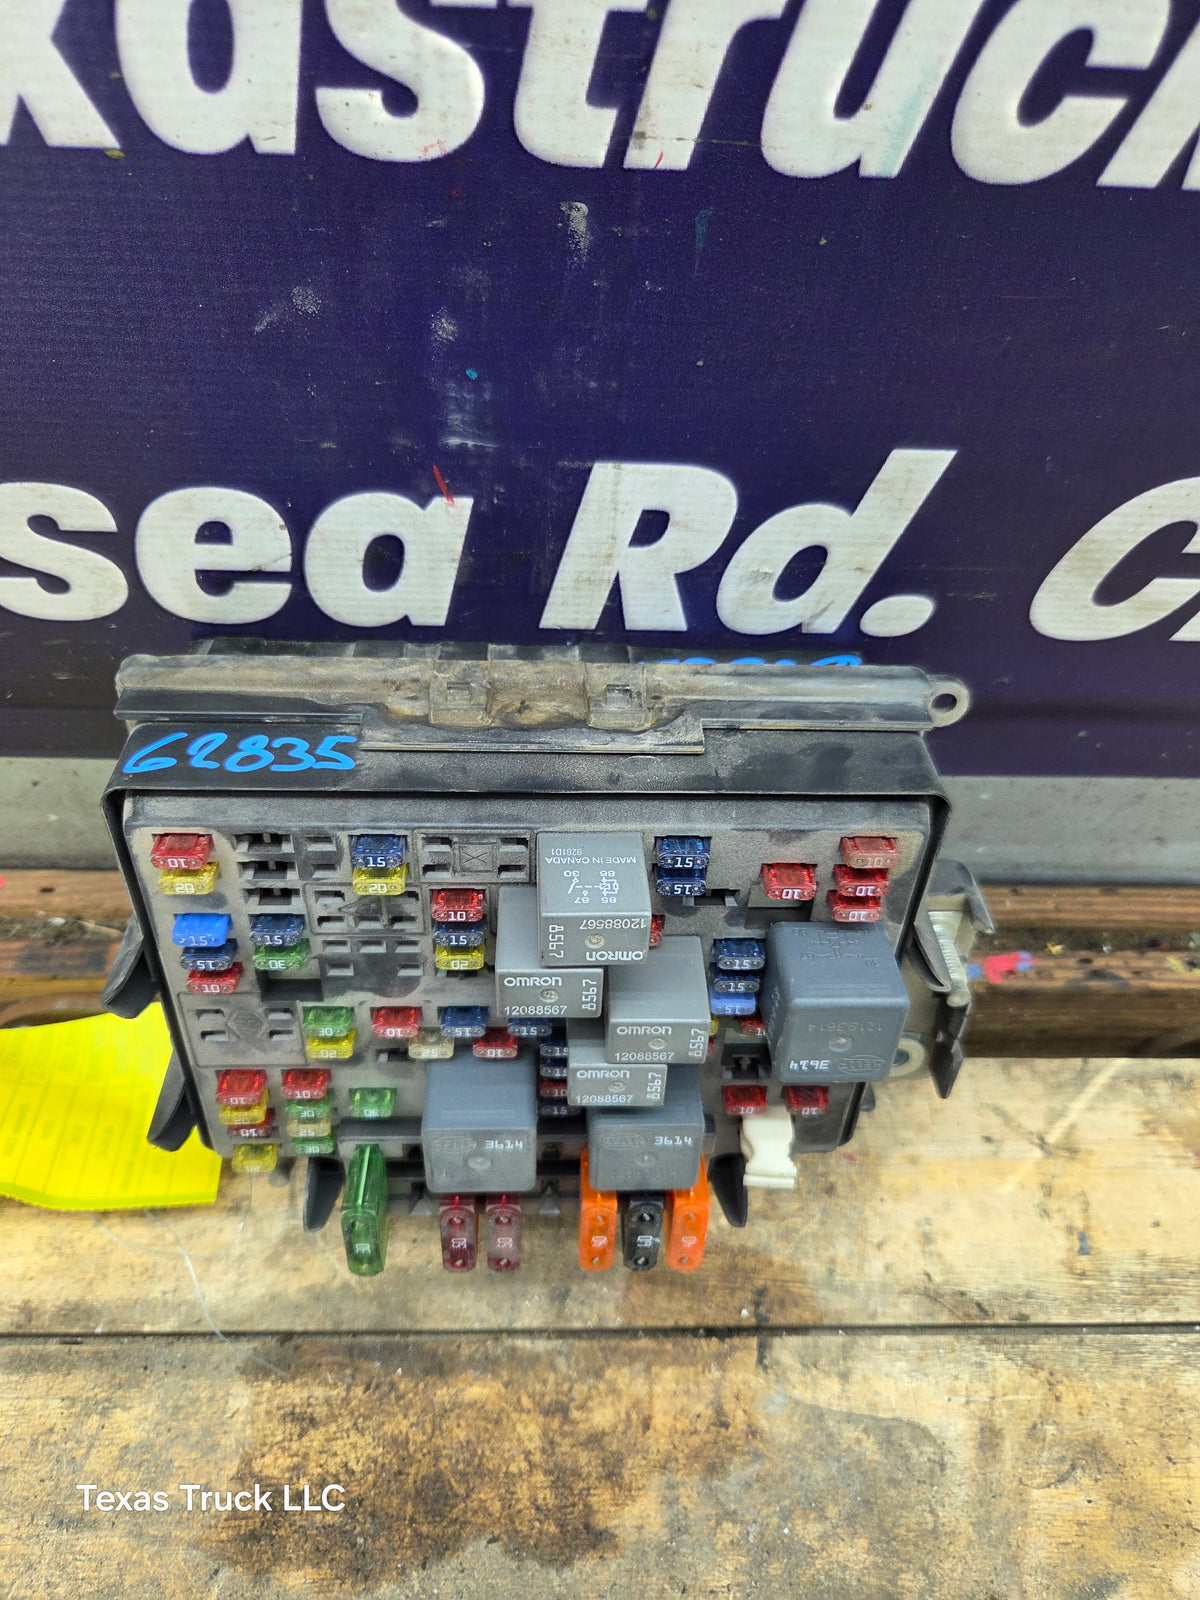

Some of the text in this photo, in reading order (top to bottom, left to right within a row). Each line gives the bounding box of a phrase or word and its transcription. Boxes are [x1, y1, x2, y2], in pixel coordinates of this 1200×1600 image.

[539, 448, 958, 638] Rd.
[1029, 476, 1200, 642] C
[122, 732, 357, 774] 62835
[167, 858, 188, 868] 10
[366, 857, 386, 867] 15
[544, 856, 637, 864] MADE IN CANADA
[674, 858, 694, 868] 15
[174, 884, 195, 894] 20
[368, 884, 388, 894] 20
[673, 884, 692, 894] 15
[782, 888, 802, 899] 10
[856, 886, 875, 896] 10
[574, 896, 590, 904] 87
[448, 912, 466, 920] 10
[849, 911, 867, 920] 10
[579, 918, 647, 930] 12088567
[190, 936, 208, 946] 15
[265, 936, 282, 944] 15
[450, 936, 468, 945] 15
[197, 960, 216, 970] 15
[732, 960, 750, 968] 15
[202, 984, 220, 992] 10
[728, 982, 745, 992] 15
[504, 1006, 568, 1016] 12088567
[725, 1005, 742, 1014] 15
[385, 1028, 403, 1037] 10
[455, 1028, 472, 1036] 15
[521, 1027, 538, 1036] 15
[614, 1052, 675, 1062] 12088567
[789, 1060, 830, 1071] 3614
[295, 1090, 310, 1098] 10
[576, 1094, 634, 1104] 12088567
[740, 1106, 754, 1114] 10
[484, 1140, 524, 1150] 3614
[654, 1136, 694, 1146] 3614
